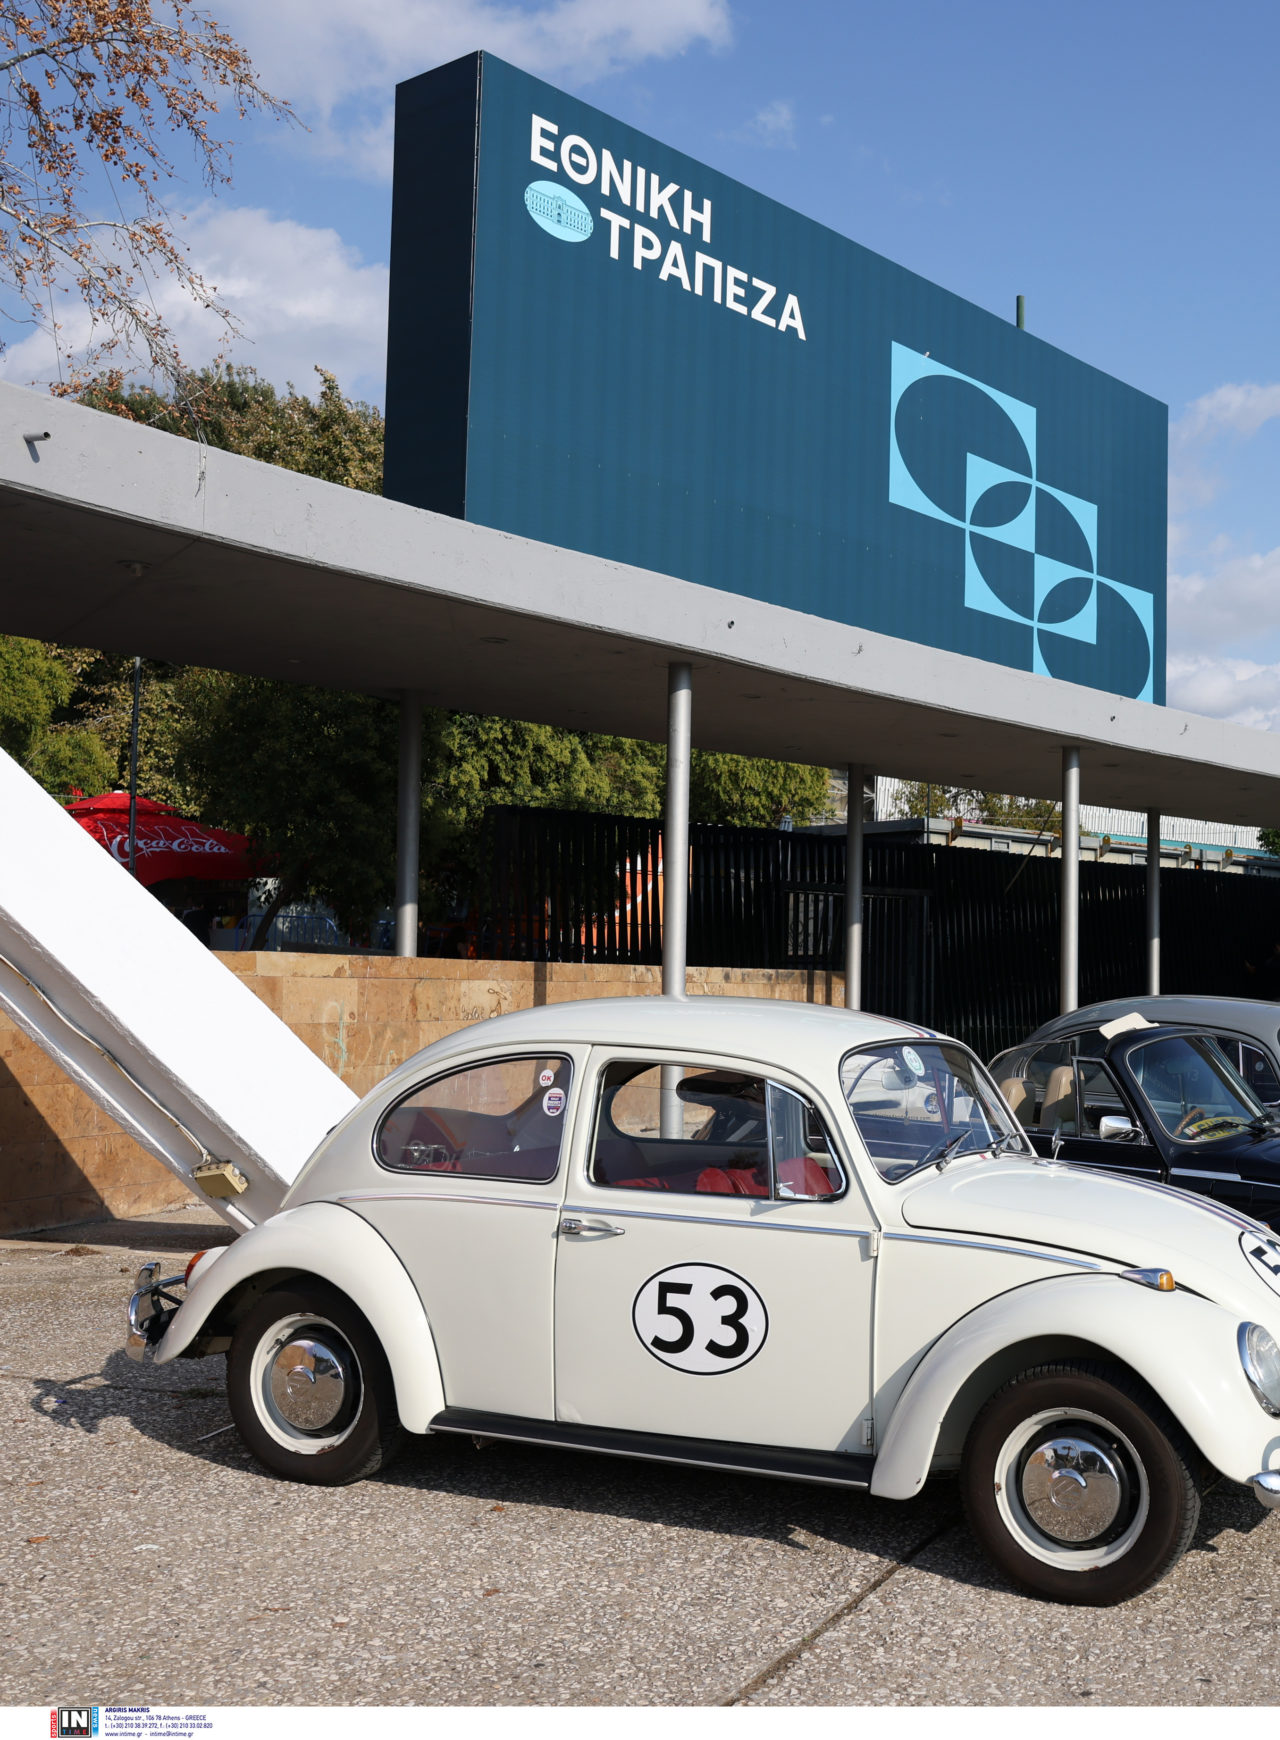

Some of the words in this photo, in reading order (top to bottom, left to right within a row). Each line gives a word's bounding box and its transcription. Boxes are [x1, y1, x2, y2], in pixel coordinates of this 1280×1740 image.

[530, 113, 711, 243] ΕΘΝΙΚΗ
[600, 207, 806, 341] ΤΡΑΠΕΖΑ
[110, 834, 230, 863] Coca-Cola
[649, 1280, 751, 1360] 53
